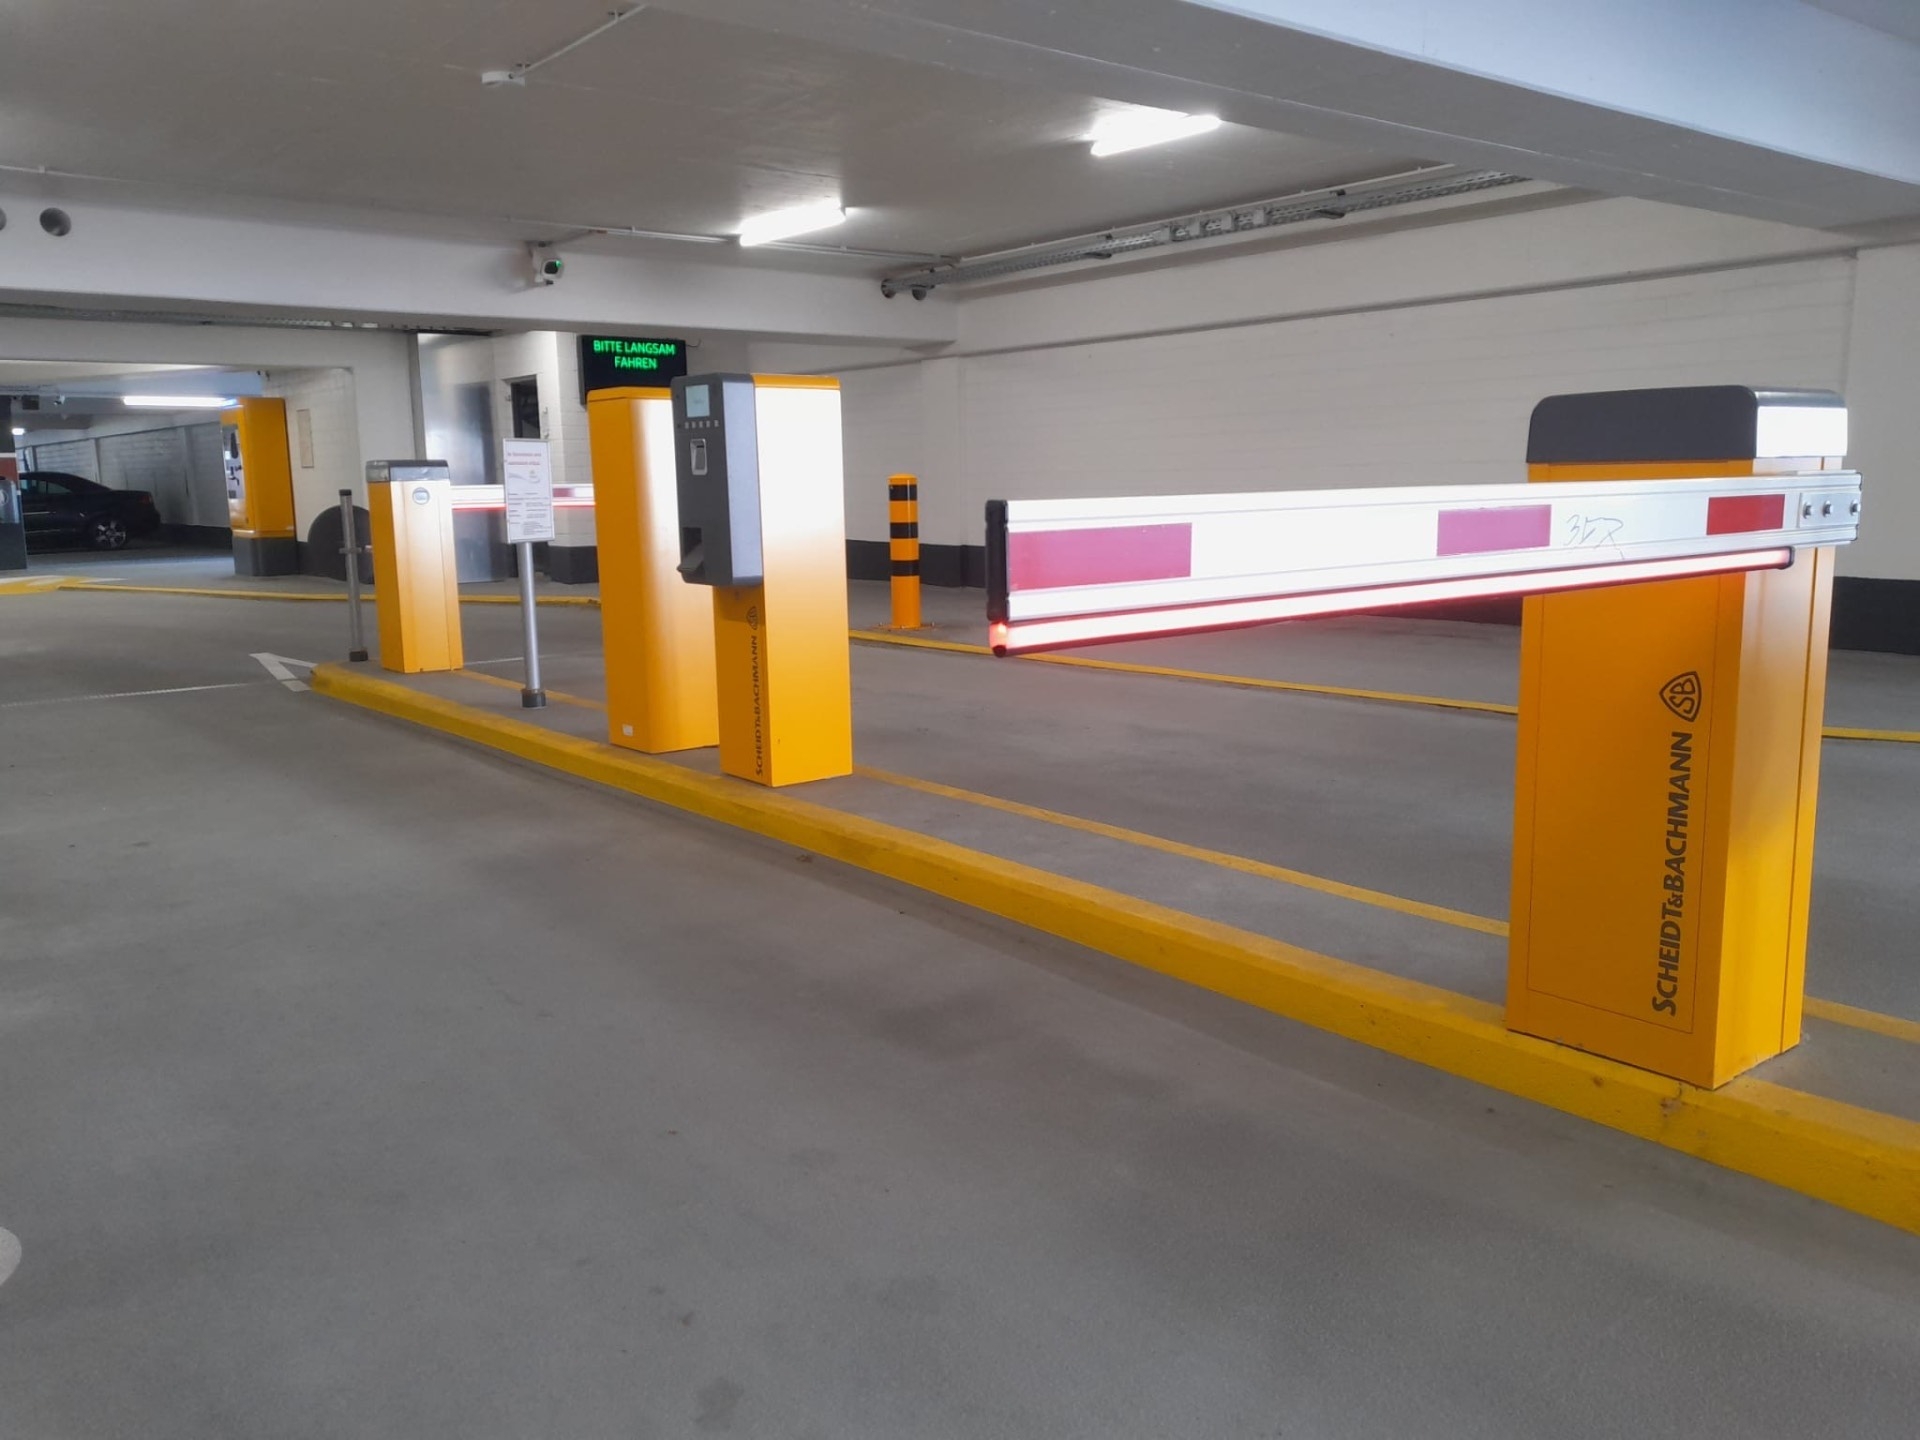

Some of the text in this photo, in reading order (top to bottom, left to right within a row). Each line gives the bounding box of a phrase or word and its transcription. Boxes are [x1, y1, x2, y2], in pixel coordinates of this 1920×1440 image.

[593, 340, 675, 355] BITTE LANGSAM
[614, 356, 657, 369] FAHREN
